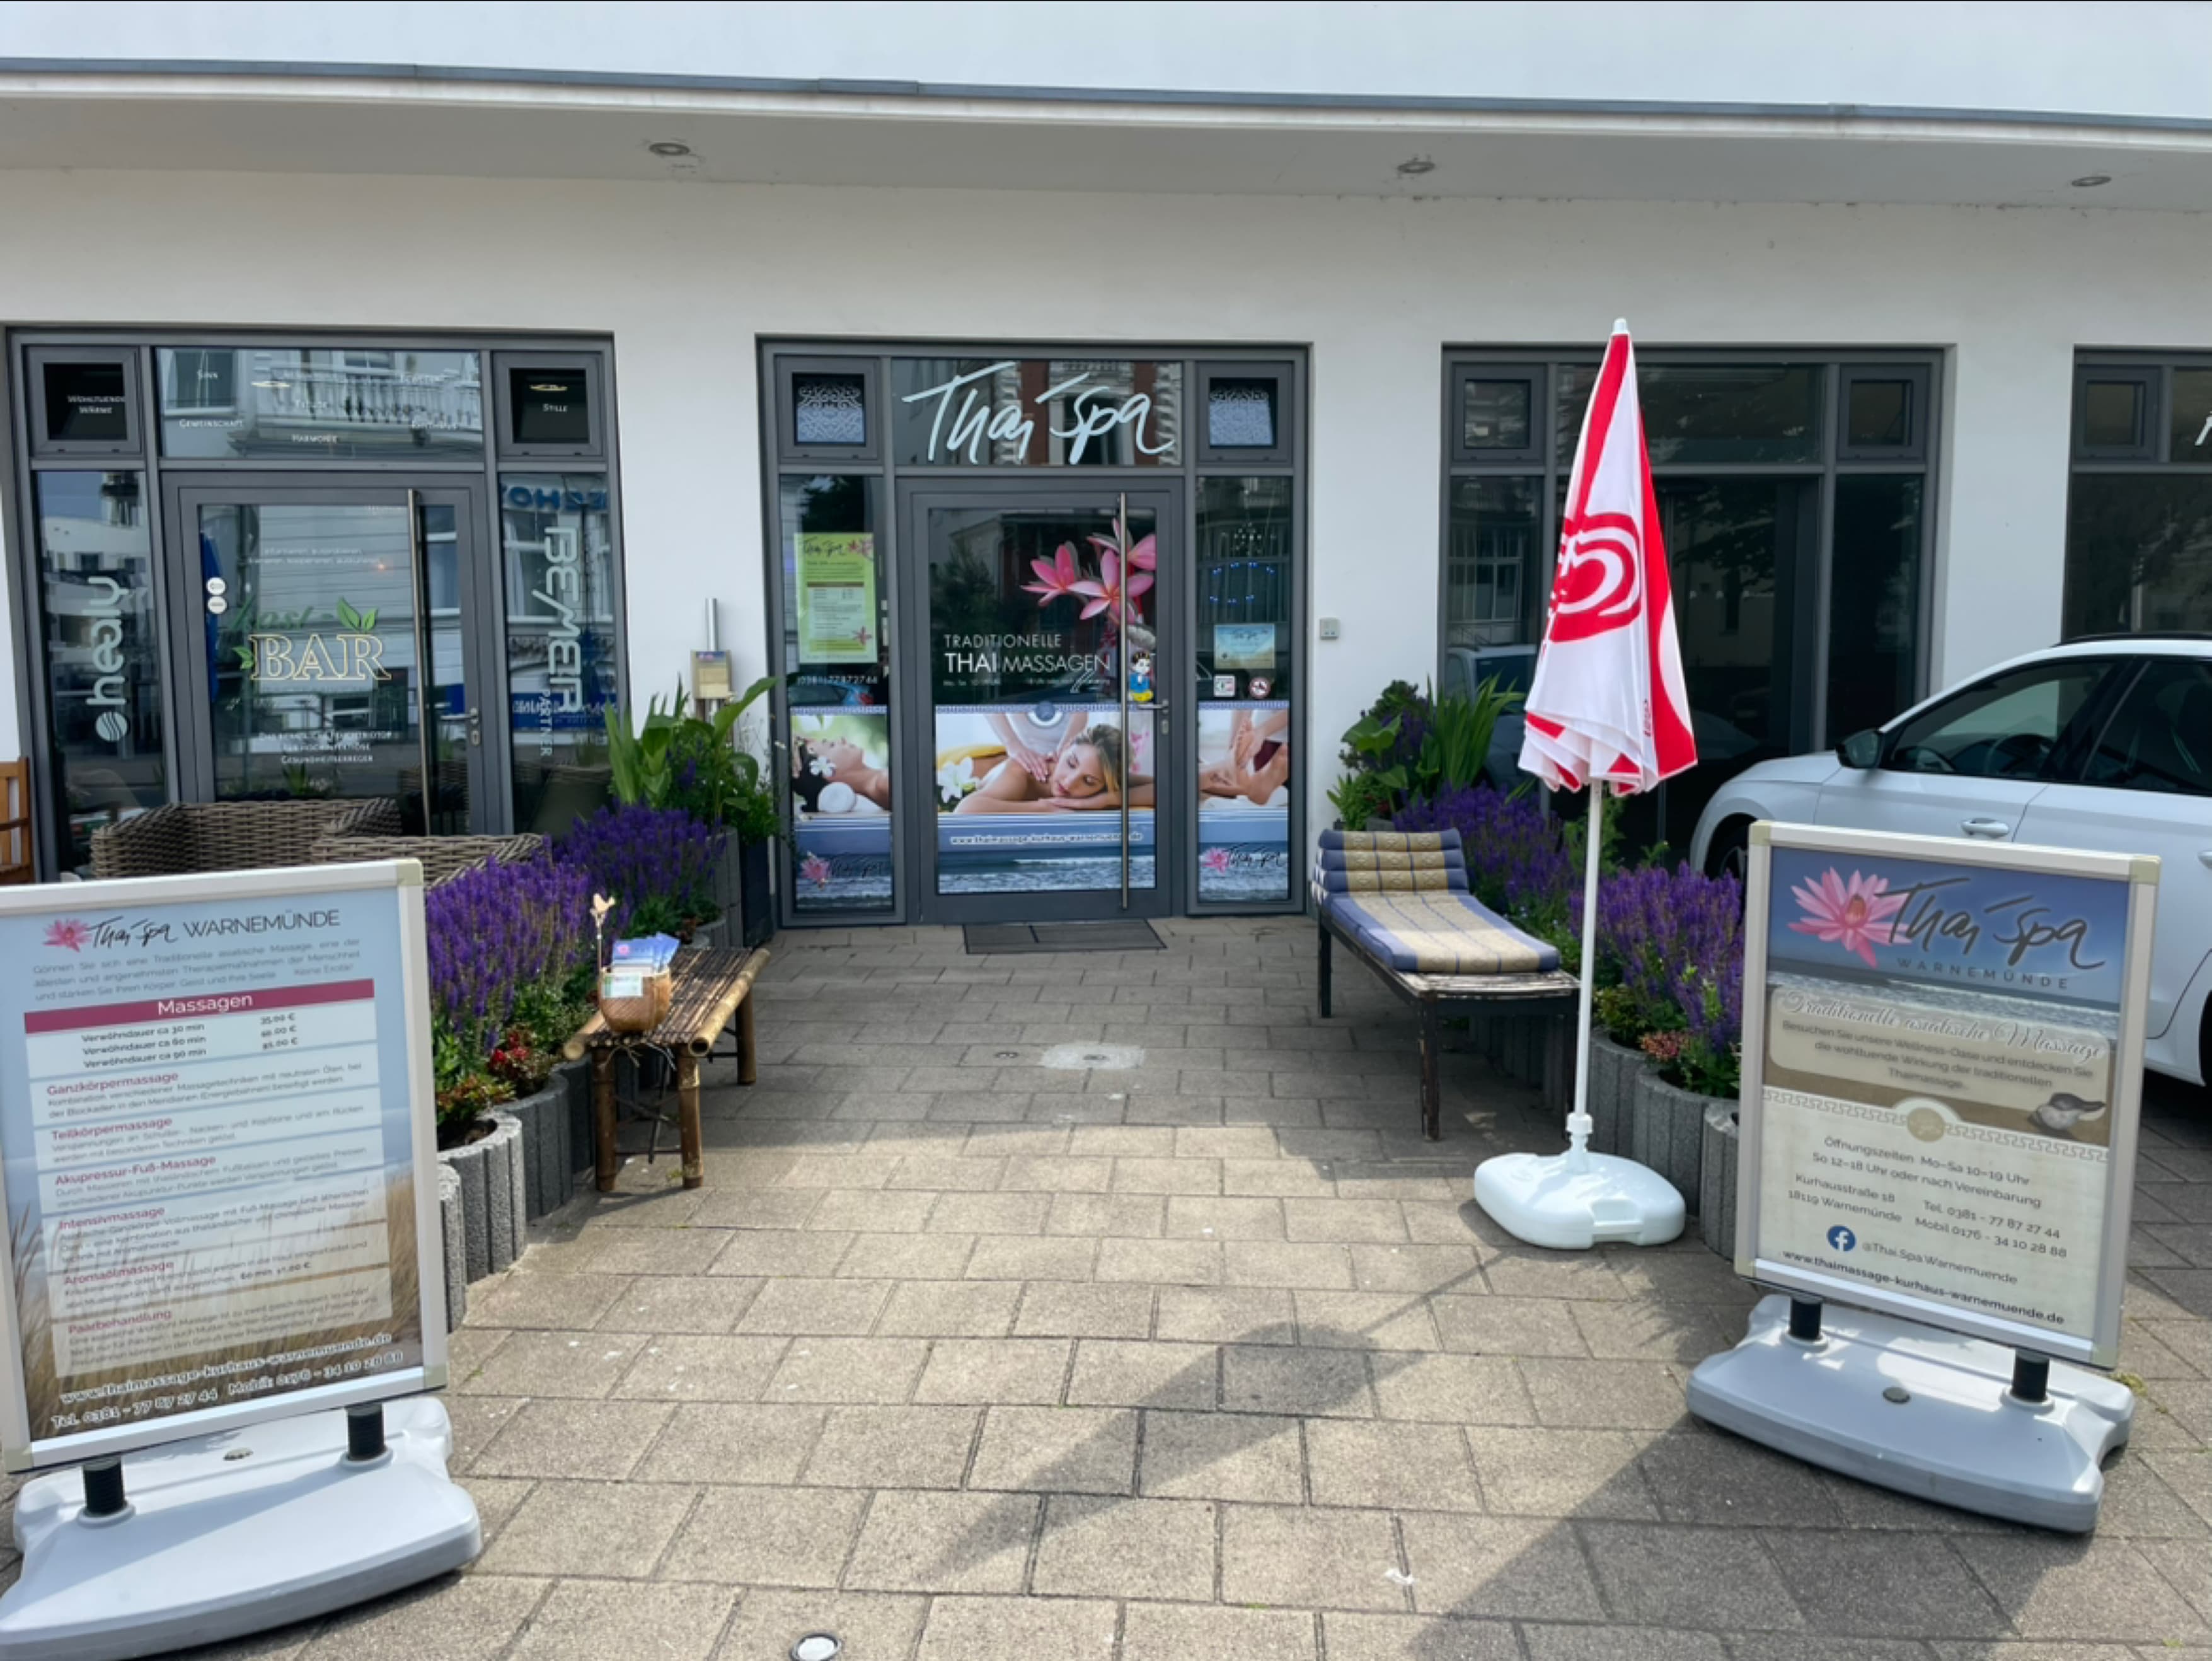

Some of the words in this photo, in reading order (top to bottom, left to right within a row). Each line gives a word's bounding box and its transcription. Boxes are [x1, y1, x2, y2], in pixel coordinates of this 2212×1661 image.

[1049, 371, 1175, 465] Spa
[82, 576, 129, 705] healy
[250, 634, 392, 680] BAR
[944, 634, 1062, 648] TRADITIONELLE
[945, 653, 997, 673] THAI
[1003, 654, 1111, 673] MASSAGEN
[182, 905, 340, 939] WARNEMÜNDE
[1874, 877, 1980, 954] Thai
[1991, 905, 2106, 969] Spa
[78, 973, 99, 985] und
[1897, 954, 2068, 990] WARNEMÜNDE
[157, 992, 253, 1018] Massagen
[81, 1027, 155, 1043] Verwöhndauer
[156, 1026, 169, 1035] ca
[185, 1022, 204, 1032] min
[83, 1039, 156, 1056] Verwöhndauer
[158, 1038, 170, 1048] ca
[186, 1034, 205, 1045] min
[1782, 1019, 1833, 1037] Besuchen
[1836, 1028, 1853, 1040] Sie
[1855, 1033, 1892, 1046] unsere
[1894, 1037, 1980, 1061] Wellness-Oase
[1981, 1051, 2005, 1065] und
[2007, 1055, 2072, 1076] entdecken
[2073, 1065, 2093, 1079] Sie
[83, 1052, 157, 1068] Verwöhndauer
[159, 1051, 171, 1060] ca
[187, 1046, 206, 1056] min
[1814, 1039, 1831, 1051] die
[1903, 1054, 1949, 1073] Wirkung
[1951, 1062, 1972, 1075] der
[1973, 1066, 2052, 1088] traditionellen
[47, 1070, 178, 1098] Ganzkörpermassage
[51, 1115, 173, 1143] Teilkörpermassage
[54, 1154, 216, 1187] Akupressur-Fuß-Massage
[1824, 1135, 1914, 1165] Öffnungszeiten
[2006, 1172, 2030, 1186] Uhr
[1795, 1172, 1878, 1200] Kurhausstraße
[1882, 1190, 1895, 1203] 18
[1812, 1151, 1828, 1164] So
[1866, 1162, 1887, 1176] Uhr
[1890, 1167, 1918, 1183] oder
[1921, 1173, 1952, 1189] nach
[1954, 1180, 2041, 1210] Vereinbarung
[59, 1205, 165, 1232] Intensivmassage
[1788, 1188, 1819, 1205] 18119
[1821, 1195, 1902, 1223] Warnemünde
[1946, 1204, 1976, 1222] 0381
[1988, 1213, 2004, 1229] 77
[2007, 1217, 2023, 1231] 87
[2026, 1221, 2041, 1236] 27
[2043, 1226, 2059, 1240] 44
[1915, 1216, 1949, 1233] Mobil
[1950, 1224, 1981, 1241] 0176
[1994, 1234, 2008, 1247] 34
[2012, 1239, 2027, 1250] 10
[2030, 1241, 2046, 1254] 28
[2049, 1245, 2067, 1259] 88
[1782, 1247, 2065, 1328] www.thaimassage-kurhaus-warnemuende.de
[67, 1307, 171, 1336] Paarbehandlung
[197, 1384, 217, 1401] 44
